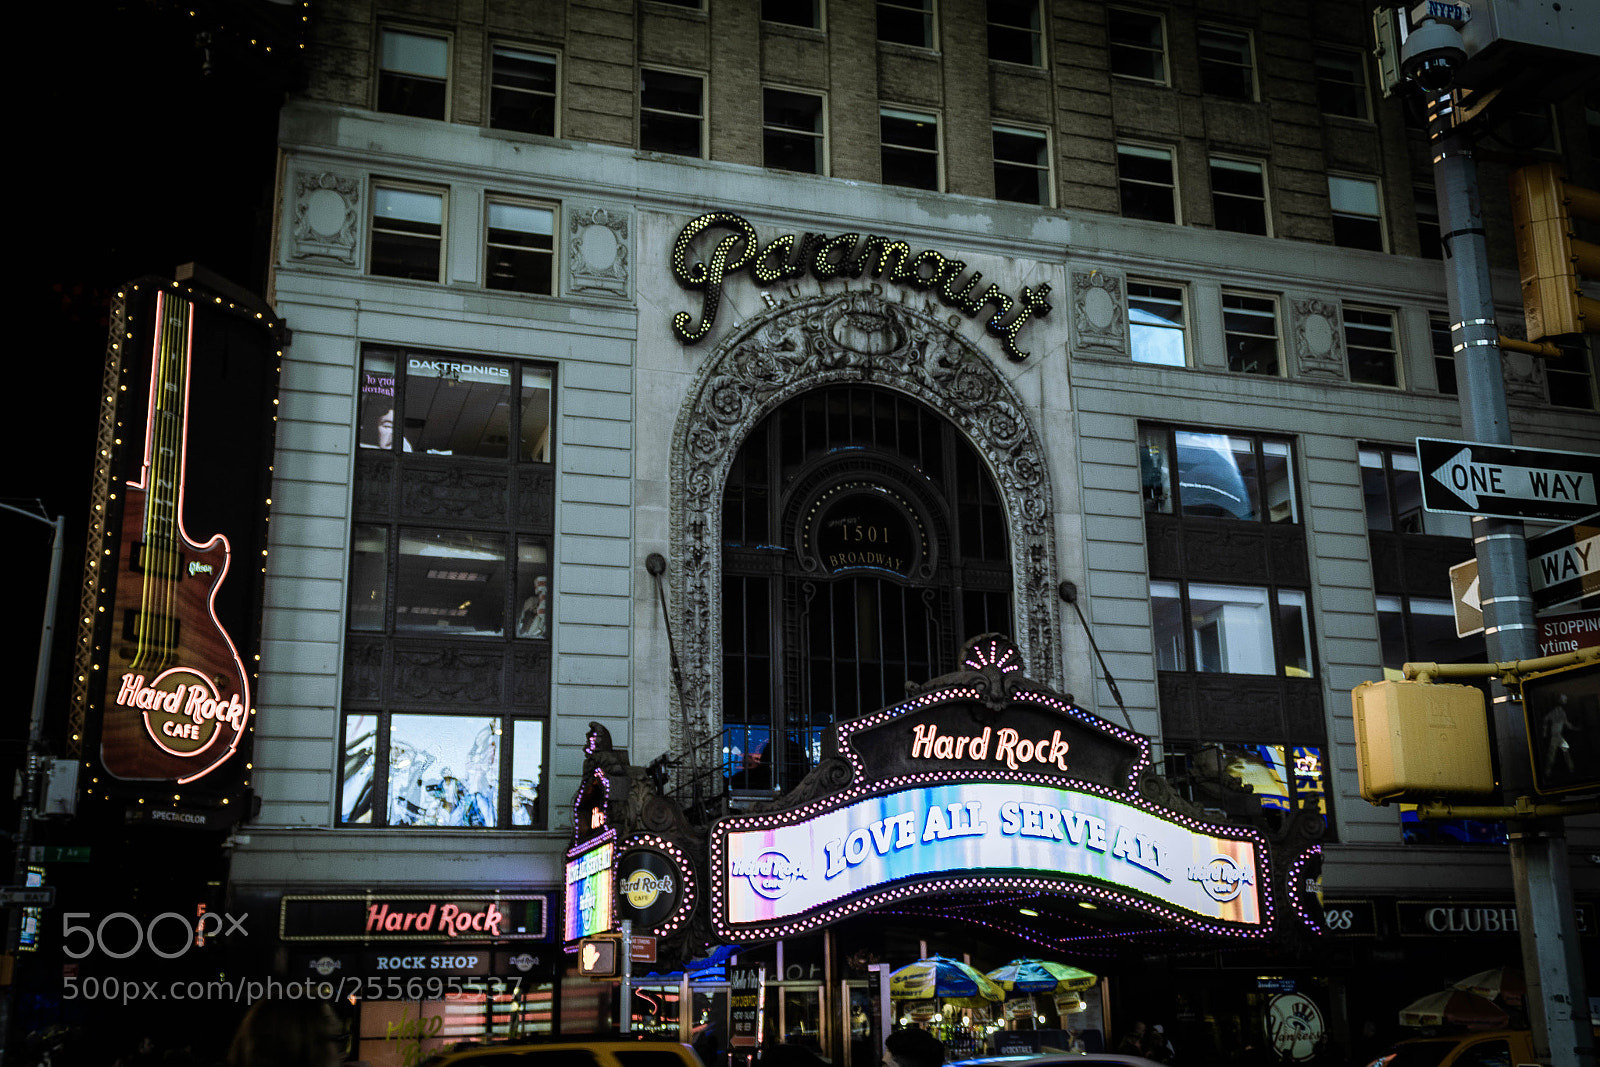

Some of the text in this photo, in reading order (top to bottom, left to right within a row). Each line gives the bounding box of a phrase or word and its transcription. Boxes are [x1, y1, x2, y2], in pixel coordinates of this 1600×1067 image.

[1429, 1, 1462, 20] NYPD
[671, 211, 1052, 362] Paramount
[761, 280, 962, 329] BUILDING
[409, 359, 509, 377] DAKTRONICS
[1452, 464, 1583, 500] ONE WAY
[842, 524, 889, 543] 1501
[829, 551, 904, 570] BROADWAY
[1541, 542, 1592, 584] WAY
[1544, 618, 1600, 637] STOPPIN
[1540, 639, 1579, 657] ytime
[116, 673, 244, 731] Hard Rock
[162, 720, 200, 741] CAFE
[911, 723, 1069, 771] Hard Rock
[151, 809, 206, 825] SPECTACOLOR
[824, 801, 1172, 884] LOVE ALL SERVE ALL
[619, 874, 673, 895] Hard Rock
[365, 903, 502, 937] Hard Rock
[1324, 907, 1588, 932] es CLUBHE
[376, 955, 479, 970] ROCK SHOP
